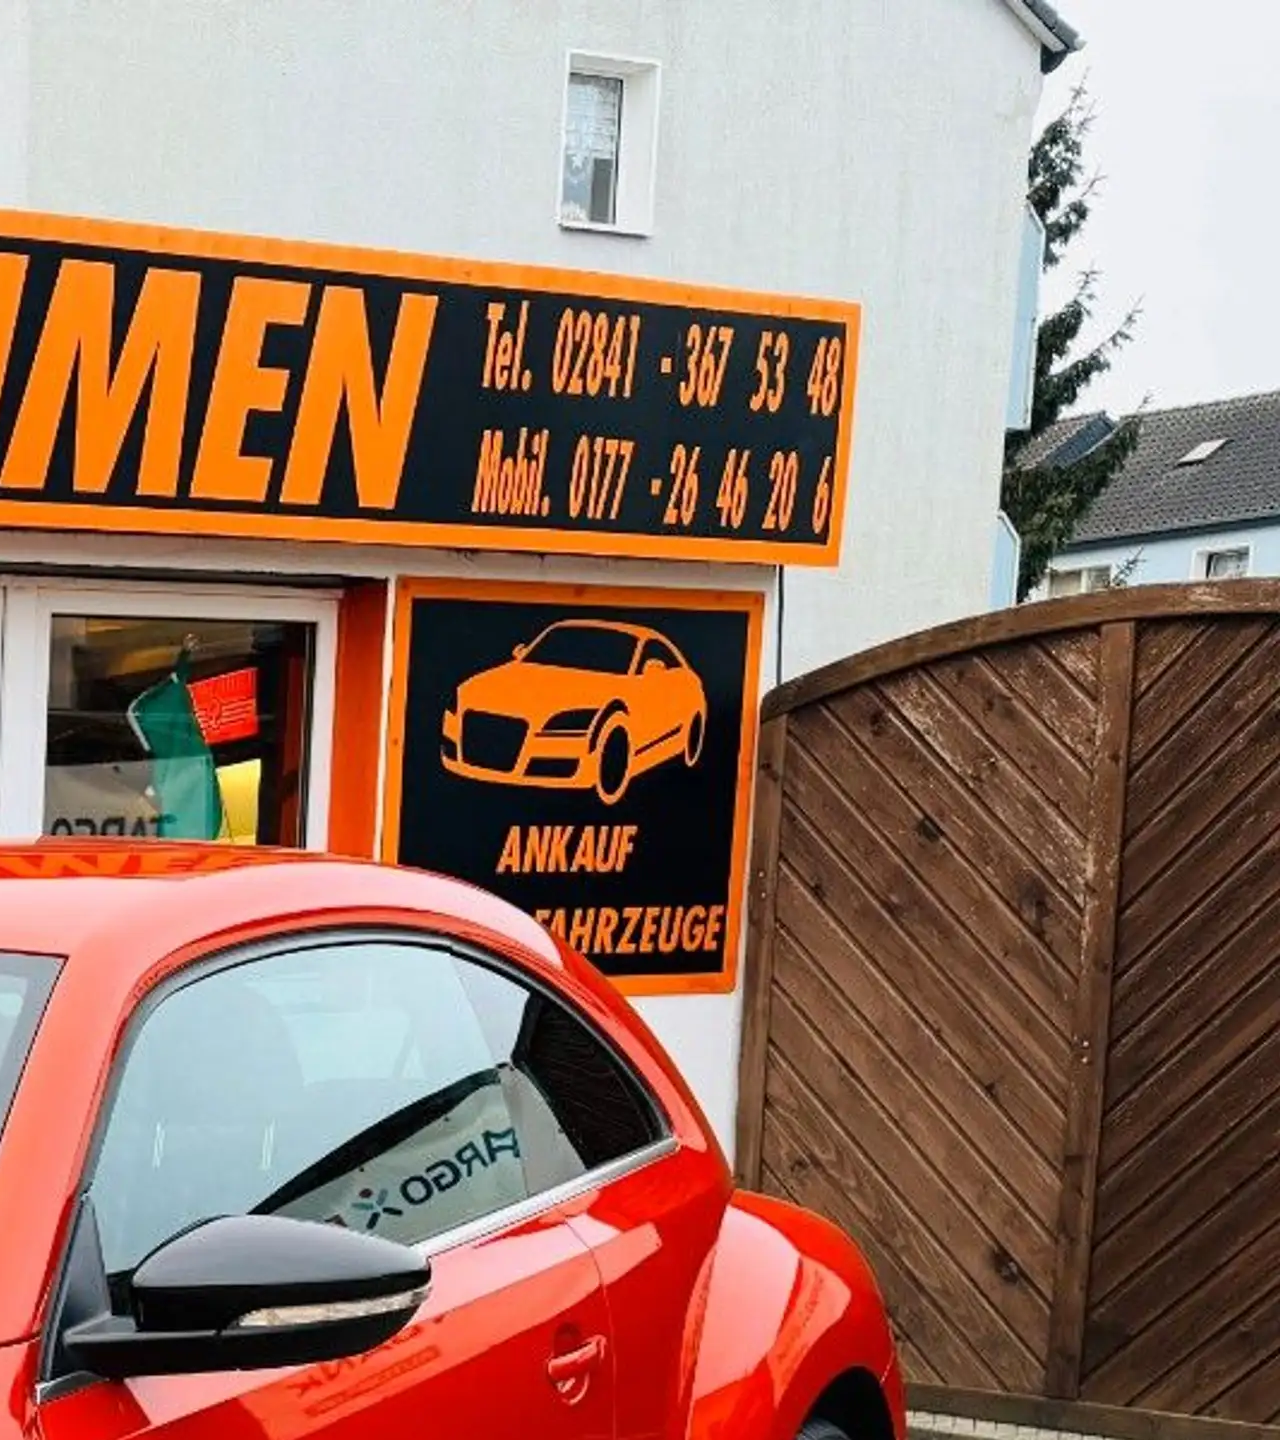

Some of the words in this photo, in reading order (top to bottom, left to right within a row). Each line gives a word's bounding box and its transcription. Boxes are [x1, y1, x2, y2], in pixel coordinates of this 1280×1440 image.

[482, 301, 532, 391] Tel.
[551, 307, 640, 398] 02841
[749, 331, 789, 413] 53
[807, 336, 841, 417] 48
[472, 427, 550, 517] Mobil.
[569, 435, 635, 520] 0177
[716, 448, 750, 529] 46
[761, 450, 799, 532] 20
[811, 456, 832, 534] 6
[496, 825, 638, 875] ANKAUF
